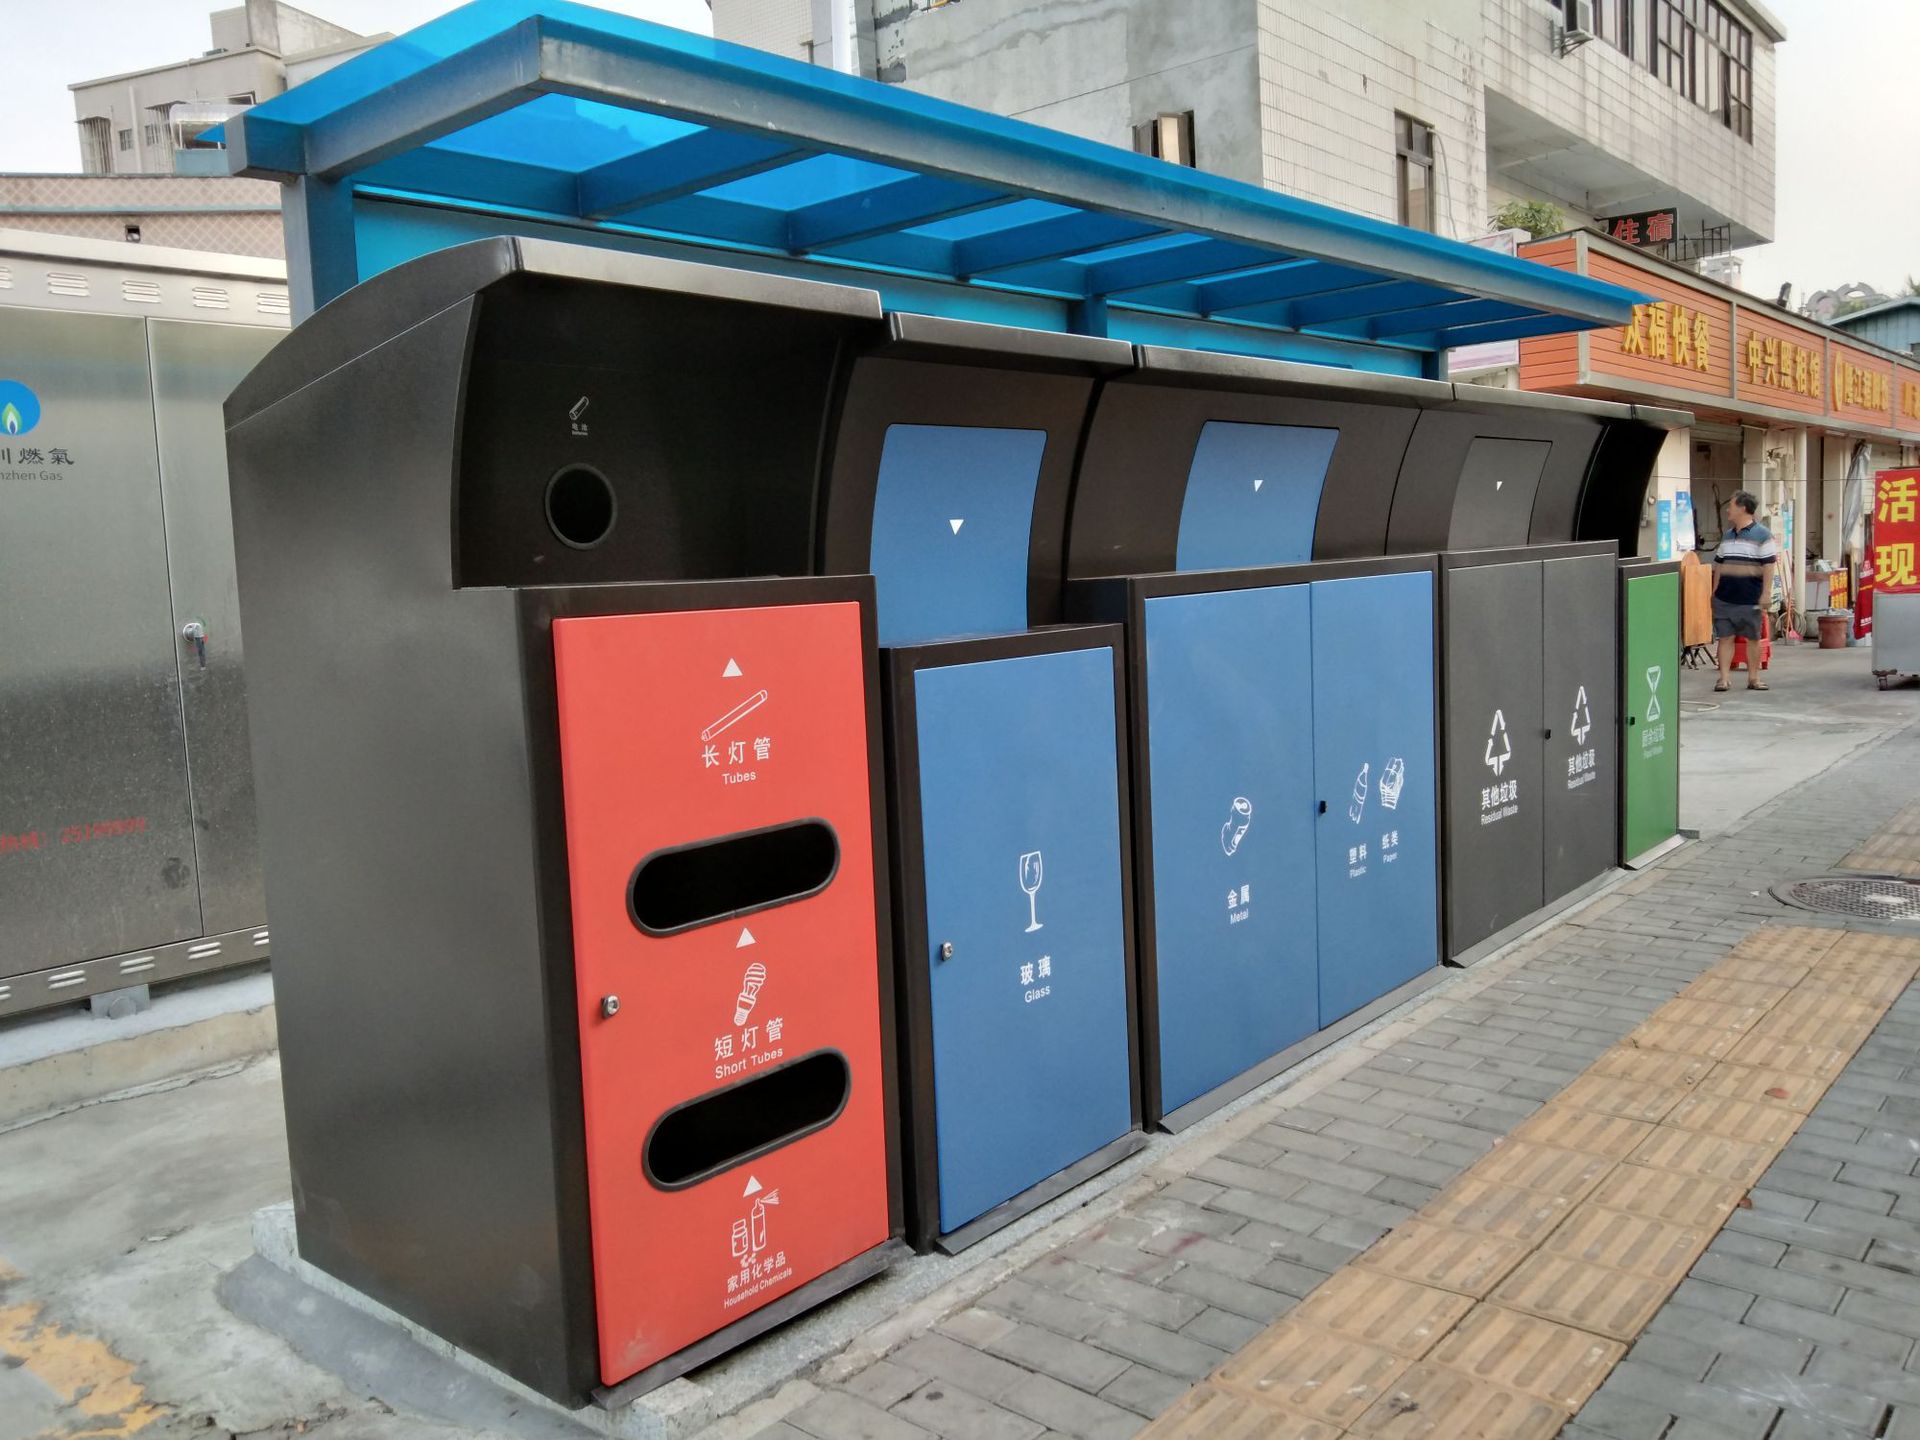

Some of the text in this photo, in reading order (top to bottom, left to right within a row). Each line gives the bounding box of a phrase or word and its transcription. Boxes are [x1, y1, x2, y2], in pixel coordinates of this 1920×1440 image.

[1612, 213, 1674, 243] 住宿
[40, 470, 63, 481] Gas
[1877, 477, 1918, 523] 活
[1875, 543, 1918, 587] 现
[701, 736, 771, 769] 长灯管
[1568, 748, 1596, 777] 其他垃圾
[722, 771, 757, 785] Tubes
[1481, 779, 1518, 811] 其他垃圾
[1349, 843, 1367, 864] 塑料
[1228, 884, 1250, 909] 金属
[1230, 908, 1249, 925] Metal
[1020, 955, 1051, 985] 玻璃
[1025, 985, 1051, 1003] Glass
[714, 1017, 783, 1061] 短灯管
[715, 1048, 783, 1079] Short Tubes
[727, 1251, 786, 1293] 家用化学品
[723, 1267, 793, 1309] Household Chemicals
